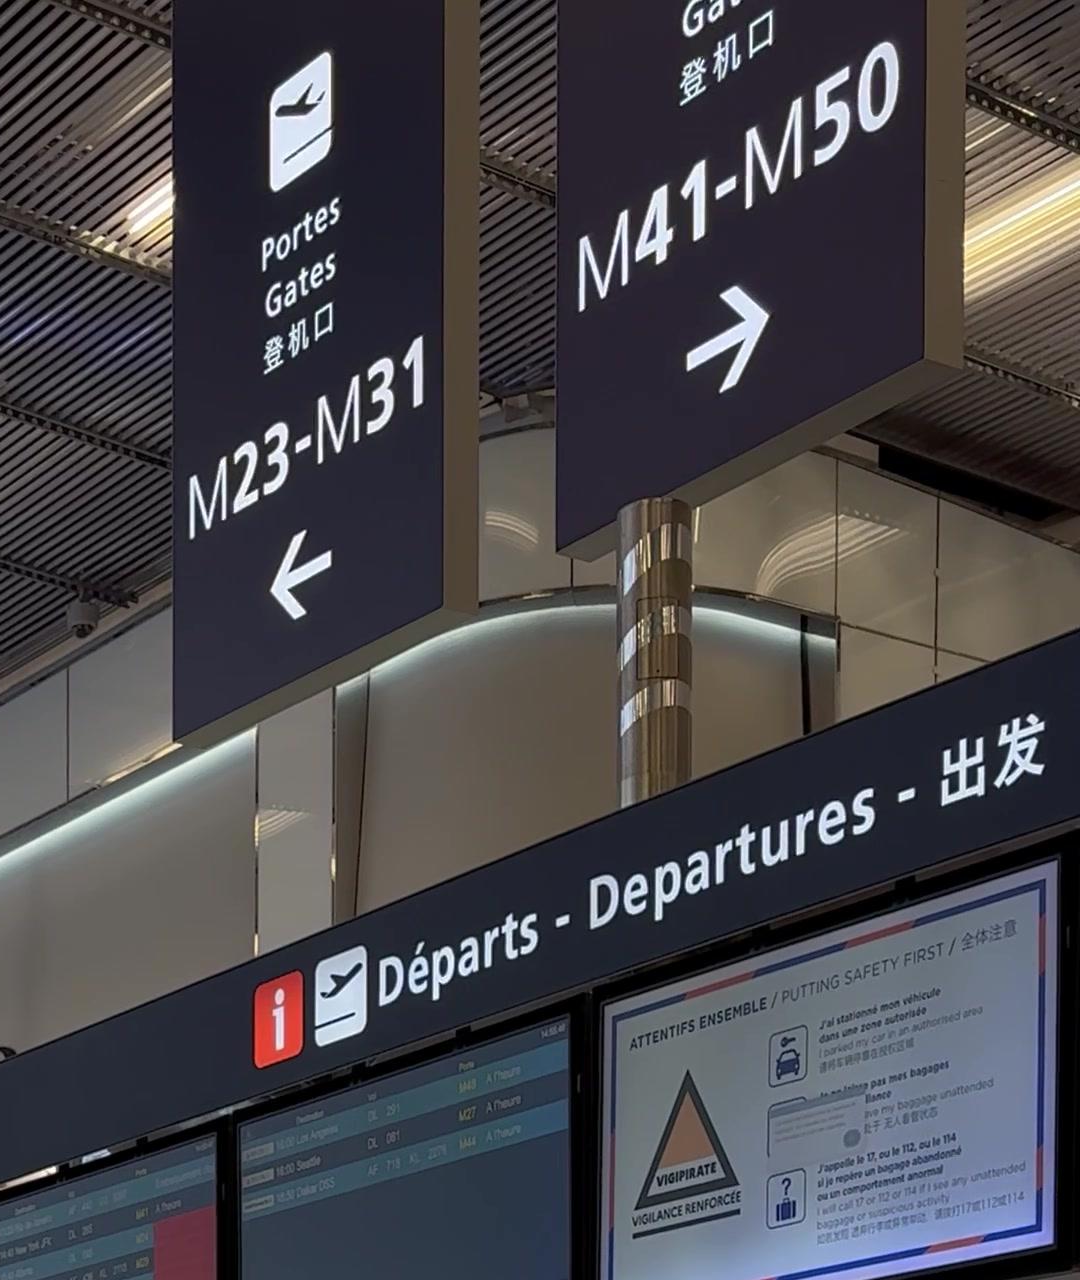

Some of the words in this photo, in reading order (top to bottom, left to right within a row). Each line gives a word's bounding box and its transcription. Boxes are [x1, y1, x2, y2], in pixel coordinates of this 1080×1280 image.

[679, 9, 774, 107] 登机口
[578, 41, 900, 313] M41-M50
[261, 196, 341, 272] Portes
[264, 252, 337, 318] Gates
[263, 301, 335, 375] 登机口
[188, 334, 425, 541] M23-M31
[378, 913, 540, 1007] Départs
[588, 785, 877, 931] Departures
[939, 712, 1048, 808] 出发
[628, 1019, 696, 1051] ATTENTIFS
[699, 996, 768, 1031] ENSEMBLE
[781, 967, 841, 1005] PUTTING
[843, 955, 900, 986] SAFETY
[903, 941, 946, 969] FIRST
[880, 1000, 901, 1013] mon
[819, 1030, 840, 1044] dans
[841, 1025, 859, 1038] une
[860, 1019, 883, 1034] zone
[884, 1006, 928, 1026] autorisée
[855, 1036, 870, 1050] my
[871, 1031, 886, 1045] car
[870, 1076, 887, 1091] pas
[888, 1070, 908, 1085] mes
[909, 1060, 950, 1081] bagages
[939, 1077, 995, 1101] unattended
[879, 1148, 891, 1160] ou
[918, 1138, 932, 1151] ou
[942, 1131, 958, 1145] 114
[656, 1161, 718, 1188] VIGIPIRATE
[830, 1188, 841, 1200] un
[842, 1173, 906, 1198] comportement
[906, 1163, 944, 1182] anormal
[864, 1166, 876, 1178] un
[877, 1157, 911, 1175] bagage
[969, 1160, 1027, 1184] unattended
[632, 1204, 684, 1228] VIGILANCE
[684, 1190, 743, 1216] RENFORCÉE
